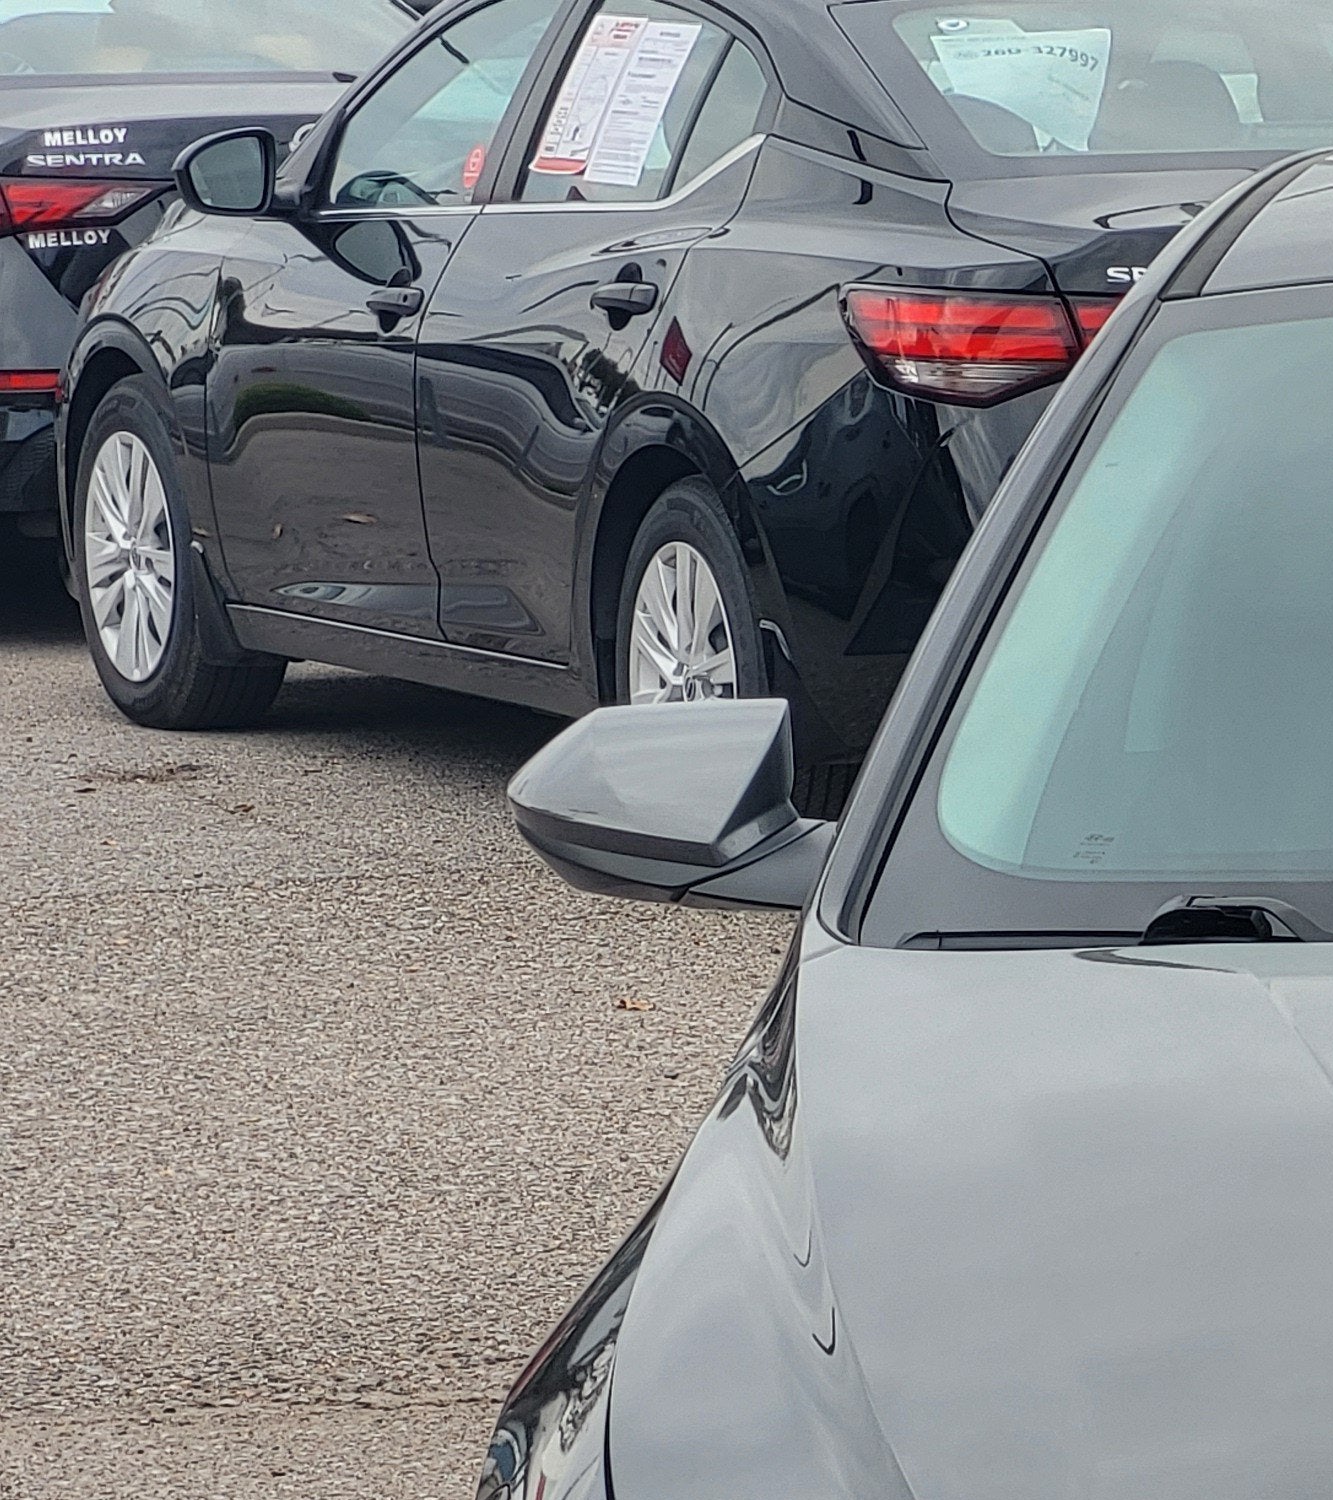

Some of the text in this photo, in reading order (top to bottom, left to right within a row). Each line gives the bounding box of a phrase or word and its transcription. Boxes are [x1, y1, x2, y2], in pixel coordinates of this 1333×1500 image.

[44, 128, 128, 147] MELLOY
[26, 152, 146, 167] SENTRA
[28, 229, 110, 249] MELLOY
